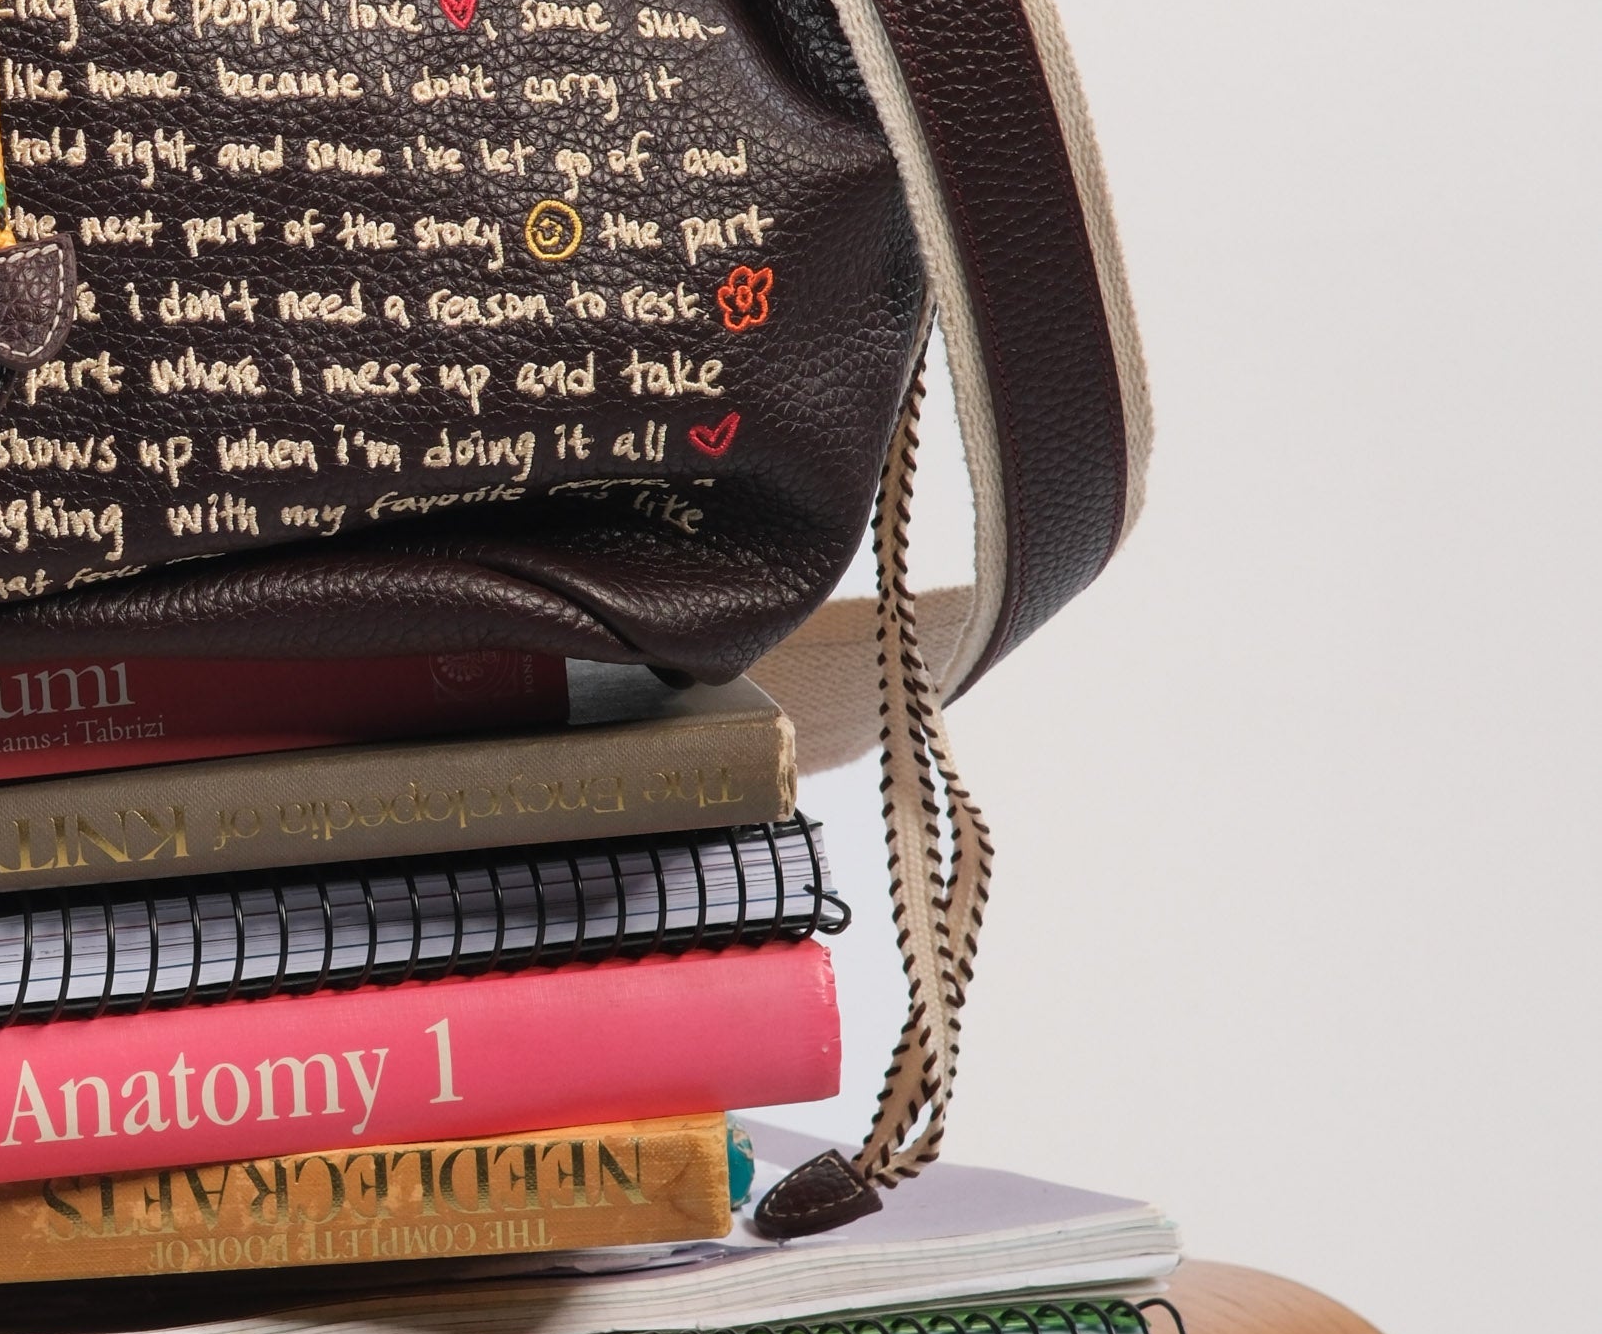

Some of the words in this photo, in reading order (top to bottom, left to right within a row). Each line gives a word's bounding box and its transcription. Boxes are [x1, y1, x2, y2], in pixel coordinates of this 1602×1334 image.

[4, 58, 69, 100] like
[216, 57, 363, 101] because
[524, 72, 619, 122] carry
[643, 66, 683, 102] it
[10, 126, 86, 167] hold
[218, 134, 284, 175] and
[305, 139, 385, 176] some
[479, 137, 535, 176] let
[555, 147, 591, 200] go
[682, 138, 748, 177] and
[80, 209, 163, 247] next
[181, 210, 265, 258] part
[283, 208, 325, 250] of
[335, 210, 398, 251] the
[413, 215, 504, 271] story
[599, 210, 661, 250] the
[679, 203, 775, 266] part
[158, 279, 259, 325] don't
[277, 280, 367, 326] need
[384, 294, 410, 329] a
[427, 288, 554, 328] reason
[565, 280, 607, 320] to
[24, 351, 124, 405] part
[150, 346, 266, 396] where
[321, 359, 422, 395] mess
[439, 363, 492, 414] up
[517, 351, 595, 397] and
[620, 349, 726, 396] take
[138, 436, 192, 487] up
[218, 428, 319, 473] when
[423, 428, 536, 483] doing
[555, 424, 594, 460] it
[612, 420, 667, 462] all
[167, 492, 259, 537] with
[281, 504, 346, 536] my
[76, 714, 166, 746] Tabrizi
[278, 774, 627, 842] Encyclopedia
[643, 767, 744, 808] The
[213, 808, 262, 852] of
[0, 1048, 389, 1146] Anatomy
[424, 1017, 464, 1104] 1
[43, 1137, 651, 1242] NEEDLECRAFTS
[203, 1232, 290, 1267] BOOK
[303, 1221, 477, 1261] COMPLETE
[490, 1218, 553, 1251] THE
